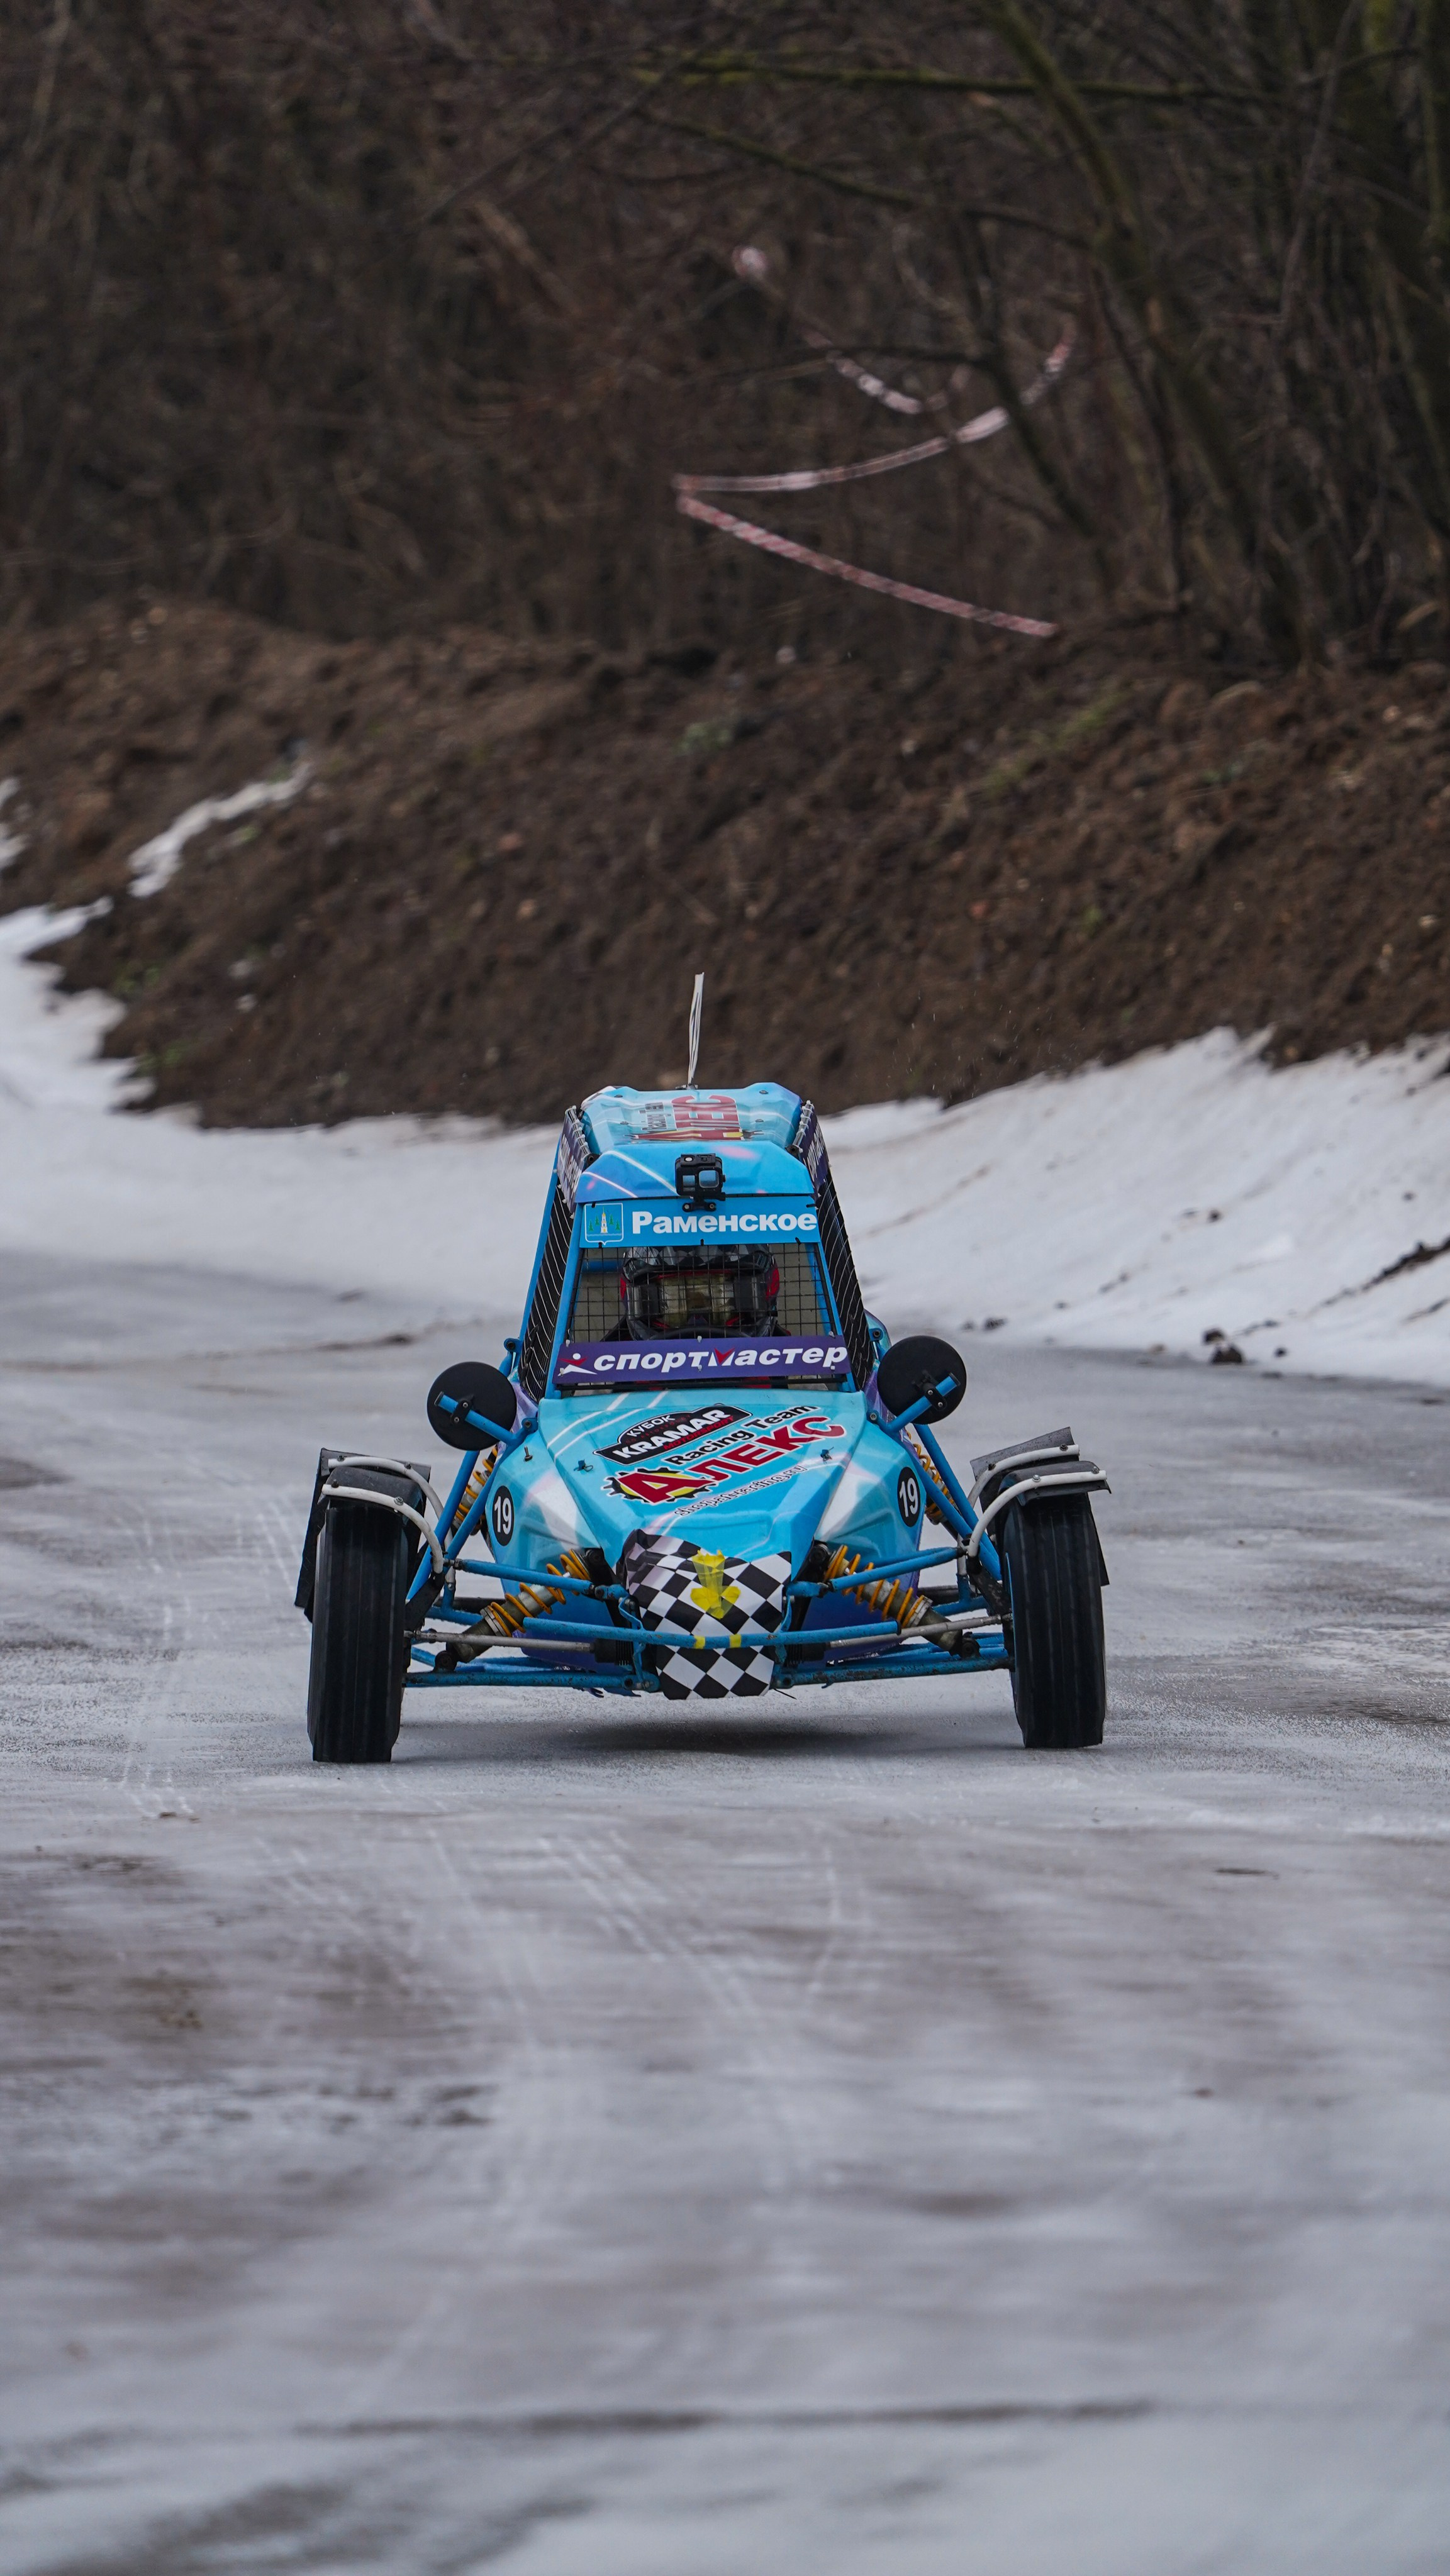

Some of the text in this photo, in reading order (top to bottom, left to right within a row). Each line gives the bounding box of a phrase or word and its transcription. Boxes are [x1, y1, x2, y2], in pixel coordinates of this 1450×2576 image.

[632, 1211, 817, 1234] Раменское
[593, 1346, 848, 1373] спортмастер
[613, 1409, 730, 1458] KRAMAR
[627, 1415, 675, 1438] КУБОК
[663, 1415, 734, 1450] MOTORSPORT
[664, 1406, 818, 1465] Racing Team
[616, 1416, 845, 1504] АЛЕКС
[494, 1496, 512, 1535] 19
[899, 1477, 918, 1518] 19
